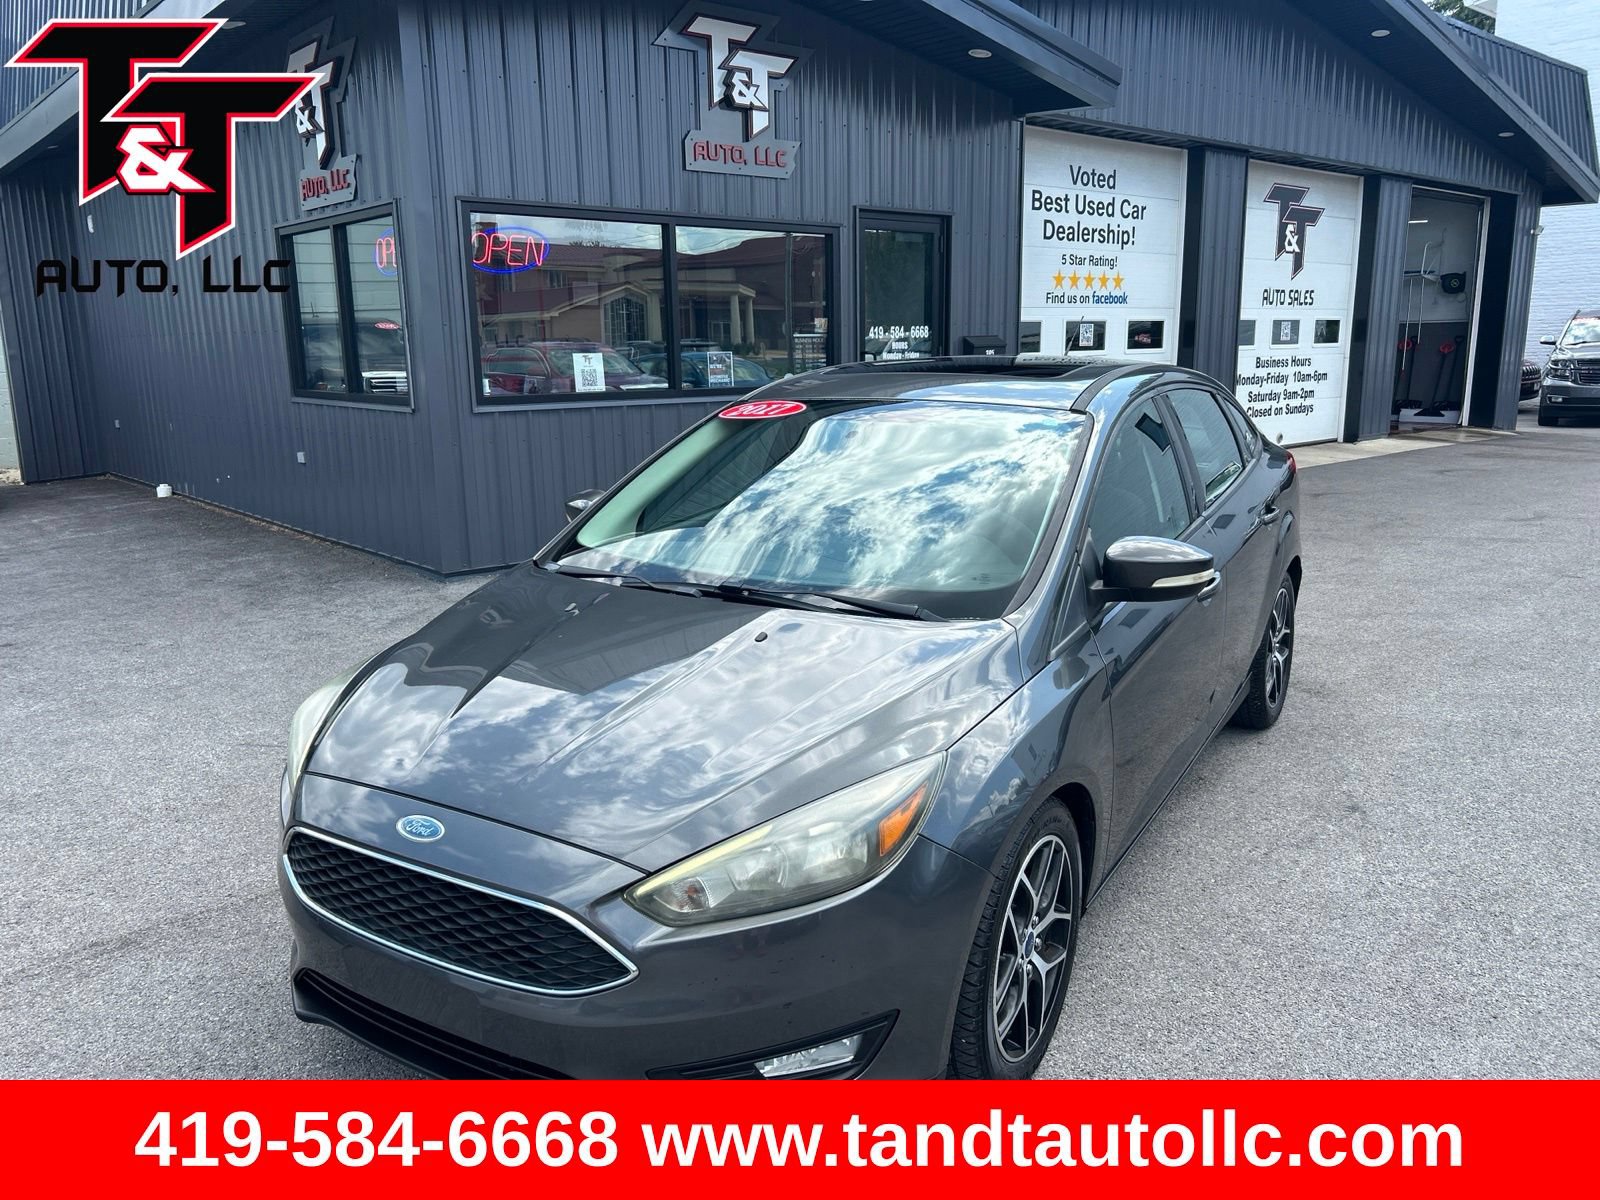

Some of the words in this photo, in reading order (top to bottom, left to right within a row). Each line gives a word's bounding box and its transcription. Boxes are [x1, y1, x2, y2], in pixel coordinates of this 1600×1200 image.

[683, 14, 798, 140] T&T
[694, 141, 748, 165] AUTO,
[755, 146, 787, 168] LLC
[330, 169, 350, 191] LLC
[1069, 164, 1117, 190] Voted
[1031, 189, 1070, 214] Best
[1075, 194, 1115, 218] Used
[1120, 199, 1147, 220] Car
[1043, 219, 1136, 250] Dealership!
[1263, 182, 1325, 281] T&T
[472, 231, 546, 267] OPEN
[1061, 254, 1067, 265] 5
[1069, 254, 1087, 266] Star
[1089, 255, 1118, 270] Rating!
[1046, 292, 1065, 304] Find
[1067, 295, 1077, 304] us
[1079, 295, 1090, 304] on
[1092, 291, 1128, 304] facebook
[1262, 288, 1286, 307] AUTO
[1288, 289, 1314, 306] SALES
[1255, 356, 1289, 369] Business
[1291, 355, 1312, 367] Hours
[1293, 370, 1328, 383] 10am-6pm
[1248, 390, 1281, 404] Saturday
[1283, 387, 1315, 401] 9am-2pm
[726, 403, 796, 416] 2017
[1246, 405, 1272, 418] Closed
[1274, 406, 1283, 416] on
[1285, 402, 1314, 416] Sundays
[405, 818, 434, 836] Ford
